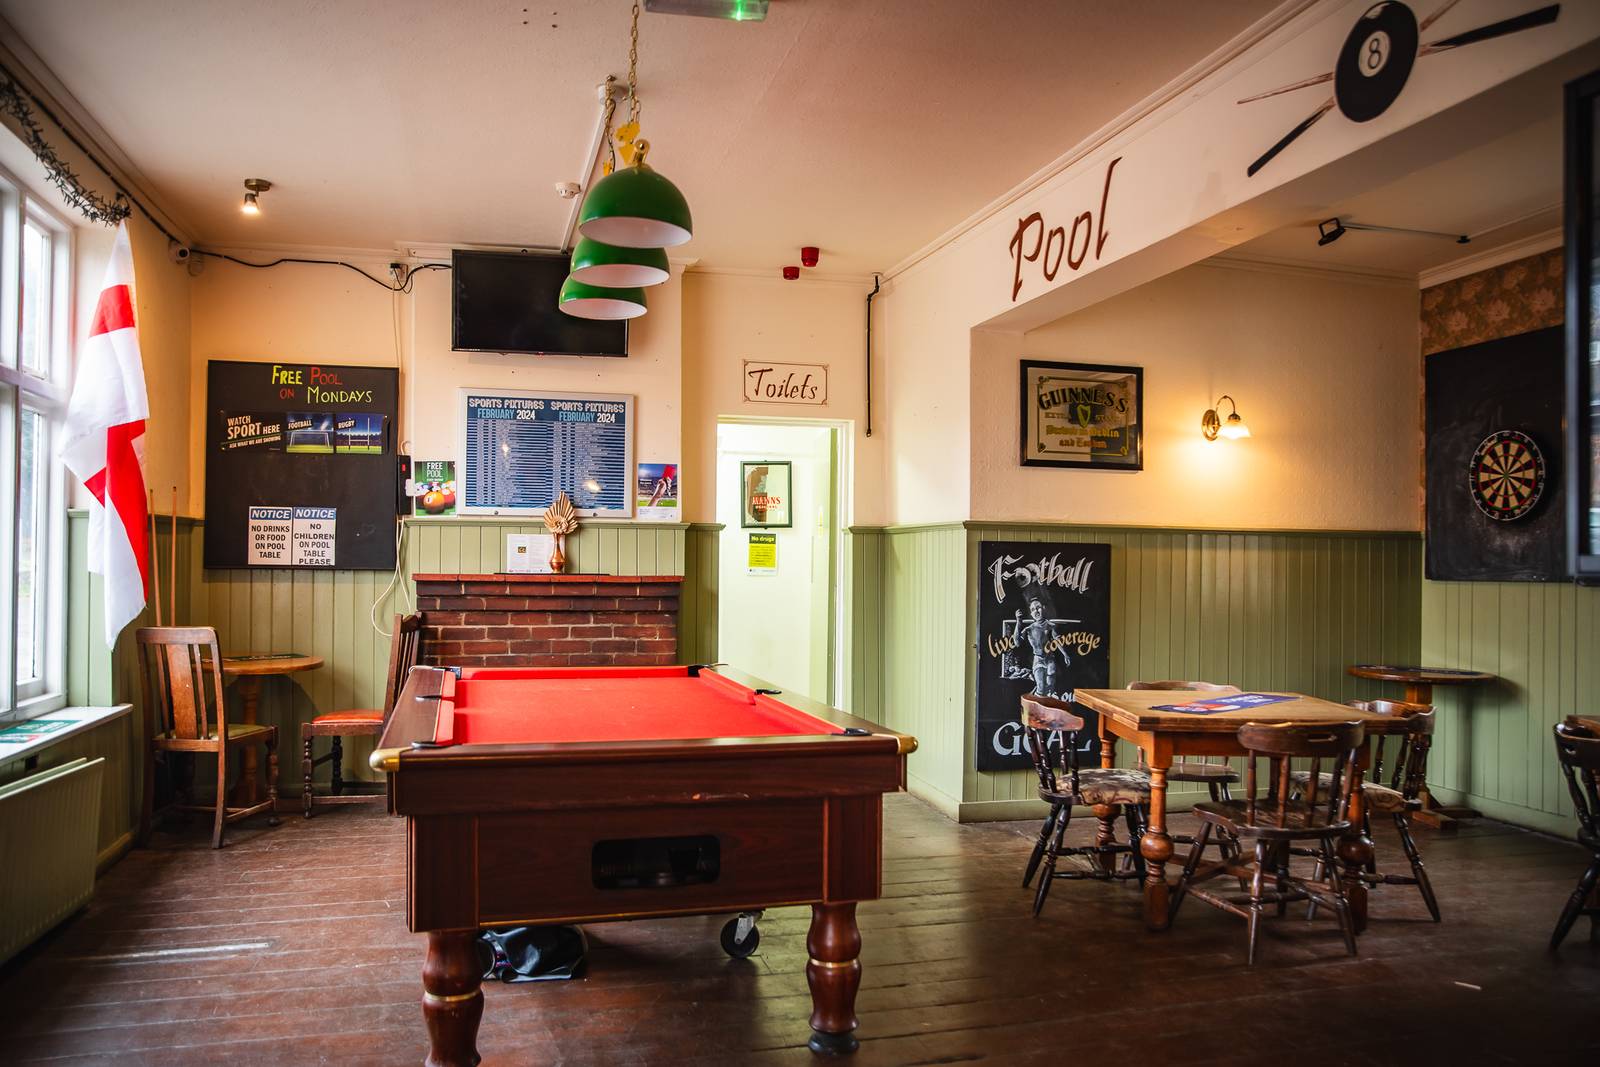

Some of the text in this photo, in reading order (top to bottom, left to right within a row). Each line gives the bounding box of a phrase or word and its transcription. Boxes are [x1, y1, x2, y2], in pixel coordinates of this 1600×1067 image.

[1367, 38, 1381, 69] 8
[1009, 156, 1122, 302] Pool
[271, 365, 343, 385] FREE POOL
[748, 367, 818, 400] Toilets
[279, 386, 373, 404] ON MONDAYS
[1038, 386, 1128, 413] GUINNESS
[468, 398, 545, 410] SPORTS FIXTURES
[550, 401, 625, 413] SPORTS FIXTURES
[477, 408, 536, 420] FEBRUARY 2024
[559, 411, 616, 423] FEBRUARY 2024
[227, 415, 251, 427] WATCH
[288, 419, 312, 430] FOOTBALL
[338, 420, 355, 429] RUGBY
[227, 422, 281, 440] SPORT HERE
[426, 462, 443, 470] FREE
[426, 469, 443, 478] POOL
[251, 509, 291, 519] NOTICE
[295, 509, 336, 519] NOTICE
[263, 525, 290, 533] DRINKS
[311, 541, 331, 549] POOL
[760, 535, 775, 543] drugs
[259, 551, 281, 559] TABLE
[988, 552, 1094, 604] Football
[988, 631, 1101, 658] live coverage
